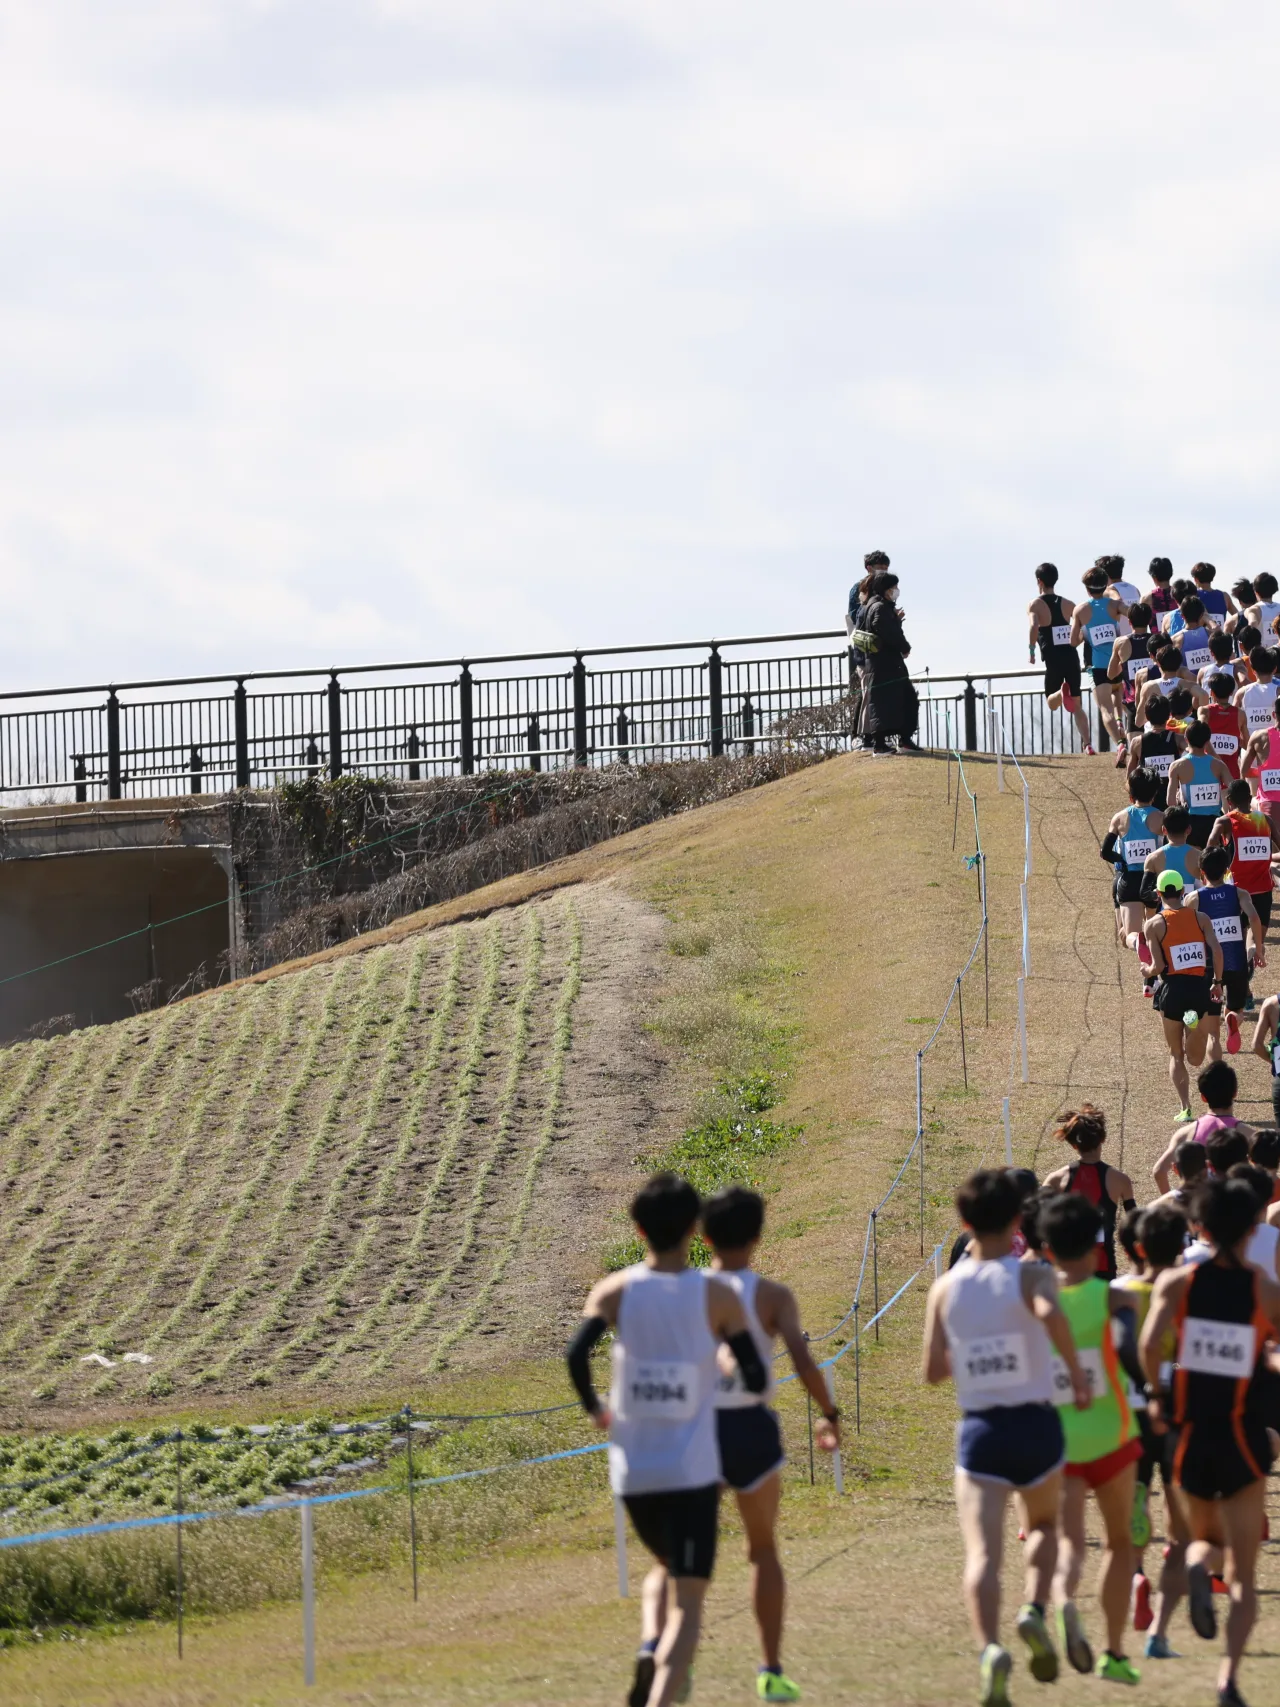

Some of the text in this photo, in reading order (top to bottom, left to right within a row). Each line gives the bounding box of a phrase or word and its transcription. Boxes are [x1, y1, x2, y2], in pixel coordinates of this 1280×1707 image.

[1094, 631, 1114, 640] 1129
[1190, 656, 1211, 664] 1052
[1249, 714, 1272, 723] 1069
[1212, 741, 1235, 750] 1089
[1194, 792, 1218, 800] 1127
[1128, 848, 1152, 858] 1128
[1242, 845, 1268, 854] 1079
[1210, 892, 1226, 900] IPU
[1214, 926, 1238, 936] 148
[1179, 944, 1198, 952] MIT
[1176, 951, 1204, 962] 1046
[966, 1354, 1018, 1377] 1092
[631, 1382, 688, 1402] 1094
